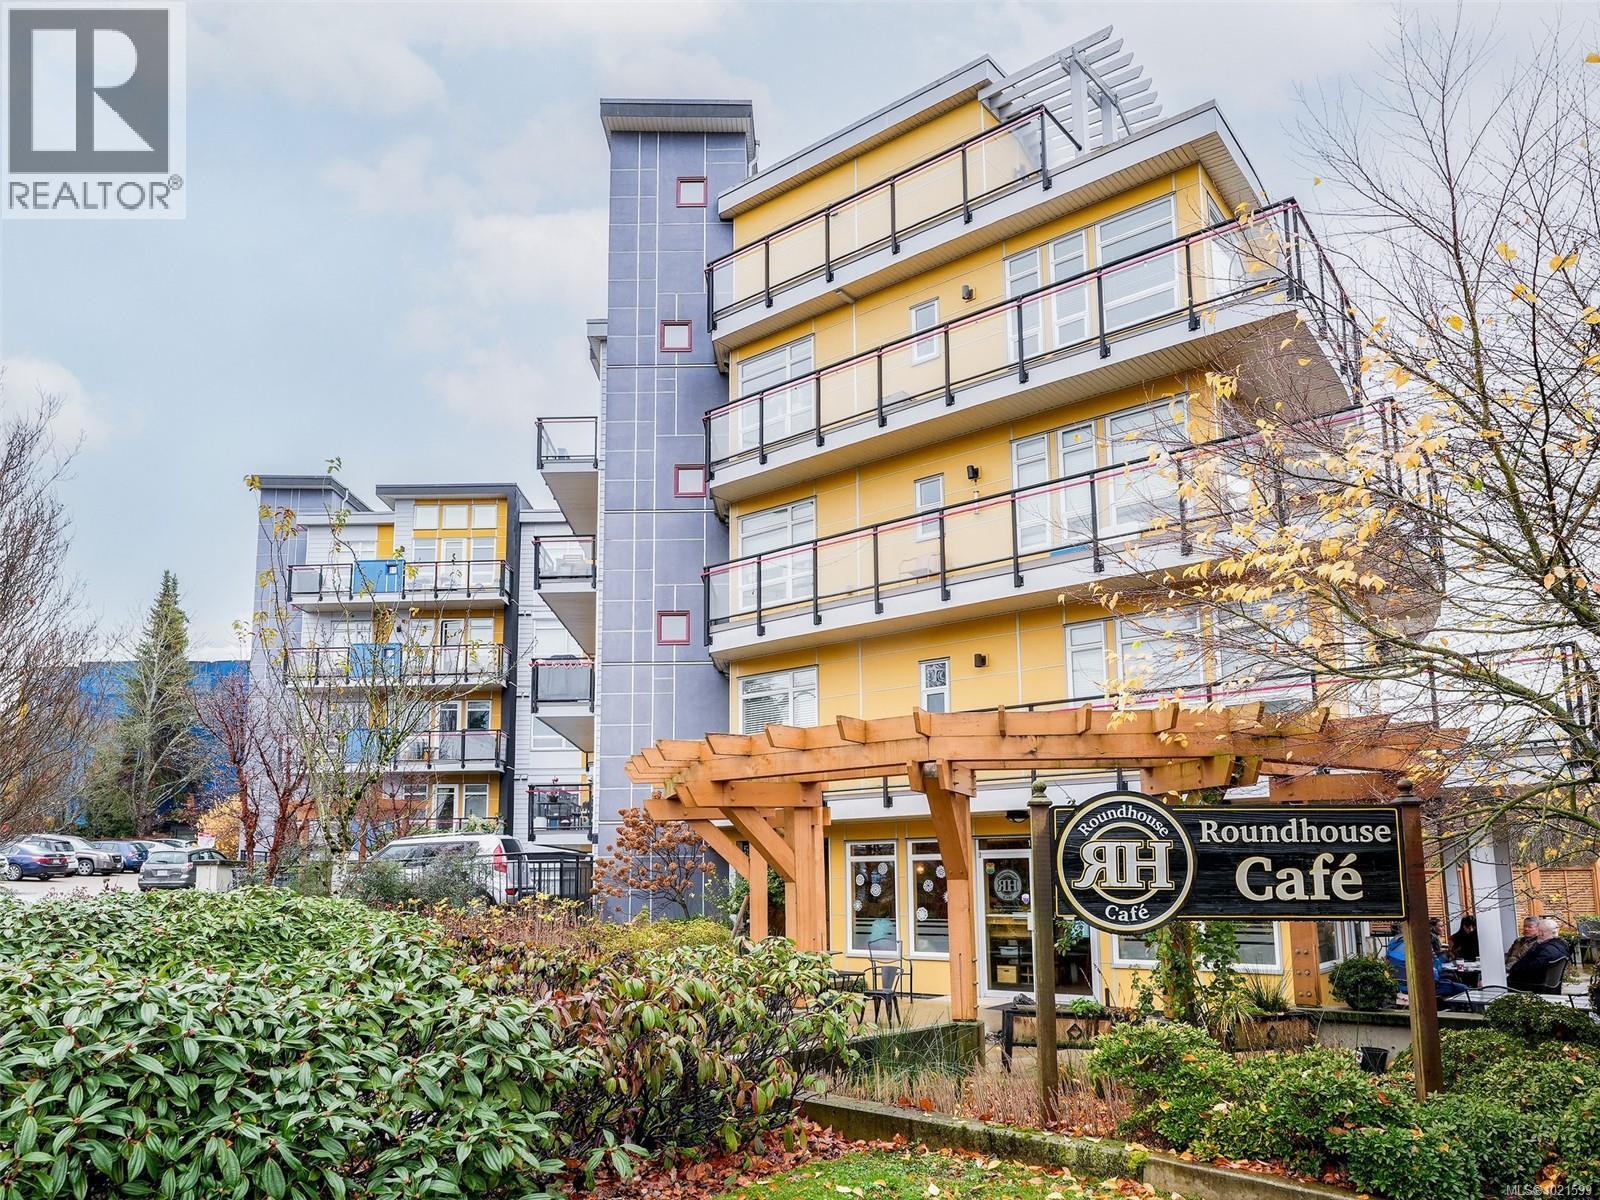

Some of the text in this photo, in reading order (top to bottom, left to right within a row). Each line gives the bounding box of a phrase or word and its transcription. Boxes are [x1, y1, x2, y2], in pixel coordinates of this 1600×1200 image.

[1078, 805, 1169, 837] Roundhouse
[1199, 818, 1392, 844] Roundhouse
[1235, 853, 1363, 901] Café
[1105, 904, 1150, 922] Café
